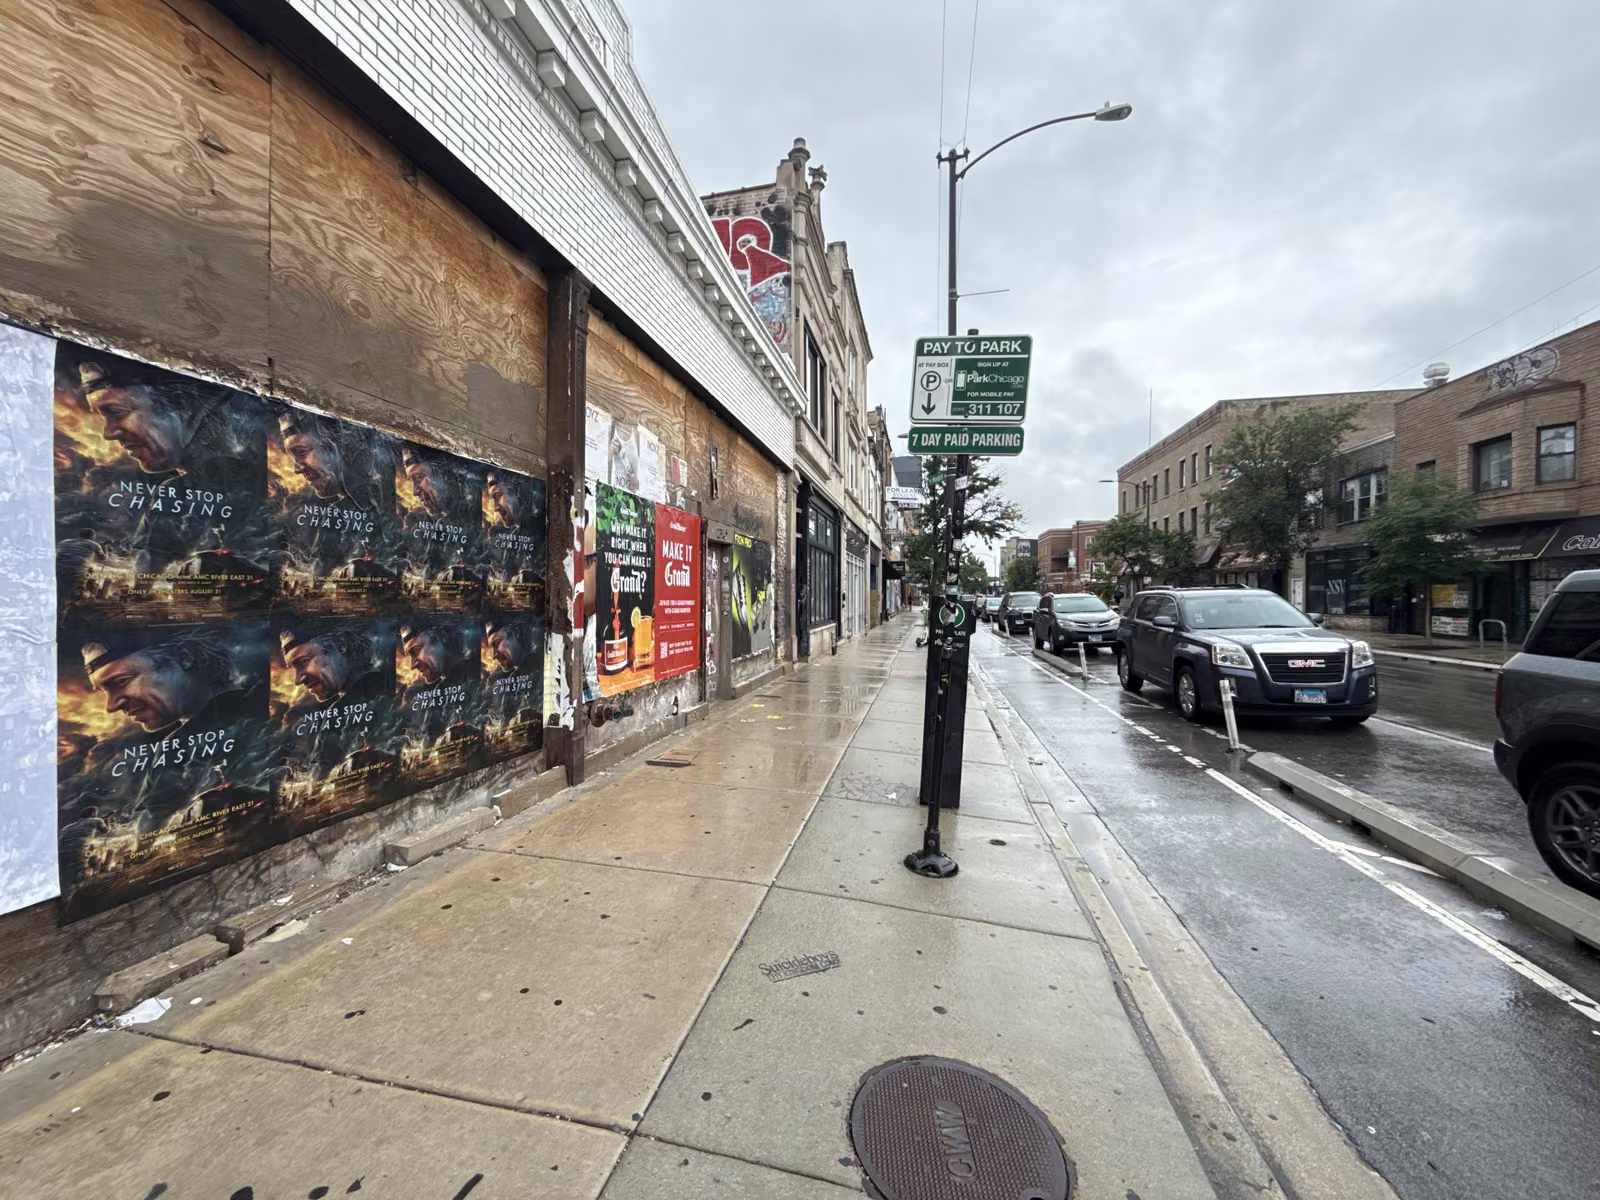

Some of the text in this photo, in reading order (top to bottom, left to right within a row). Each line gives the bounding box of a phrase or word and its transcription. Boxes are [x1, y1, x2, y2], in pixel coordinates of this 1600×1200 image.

[923, 340, 1022, 354] PAY TO PARK
[926, 374, 937, 388] P
[967, 373, 1025, 385] ParkChicago
[968, 403, 991, 415] 311
[997, 403, 1020, 414] 107
[912, 433, 1021, 446] 7 DAY PAID PARKING
[121, 480, 224, 503] NEVER STOP
[108, 493, 233, 518] CHASING
[304, 505, 367, 520] NEVER STOP
[297, 514, 374, 532] CHASING
[418, 521, 463, 534] NEVER STOP
[611, 520, 647, 538] WHY MAKE IT
[413, 529, 467, 544] CHASING
[498, 533, 517, 541] NEVER
[495, 540, 534, 551] CHASING
[631, 540, 647, 553] WHEN
[662, 539, 693, 562] MAKE IT
[604, 552, 616, 564] YOU
[618, 553, 630, 565] CAN
[631, 555, 645, 567] MAKE
[611, 567, 647, 593] Grand?
[665, 561, 690, 587] Grand
[1287, 659, 1326, 667] GMC
[416, 685, 462, 700] NEVER STOP
[412, 692, 466, 711] CHASING
[304, 703, 367, 722] NEVER STOP
[296, 711, 374, 736] CHASING
[124, 729, 225, 759] NEVER STOP
[111, 739, 235, 777] CHASING
[139, 825, 177, 841] CHICAGO
[194, 814, 211, 824] AMC
[212, 808, 230, 817] RIVER
[231, 803, 246, 812] EAST
[192, 827, 216, 838] AUGUST
[758, 951, 839, 975] Suicideboys
